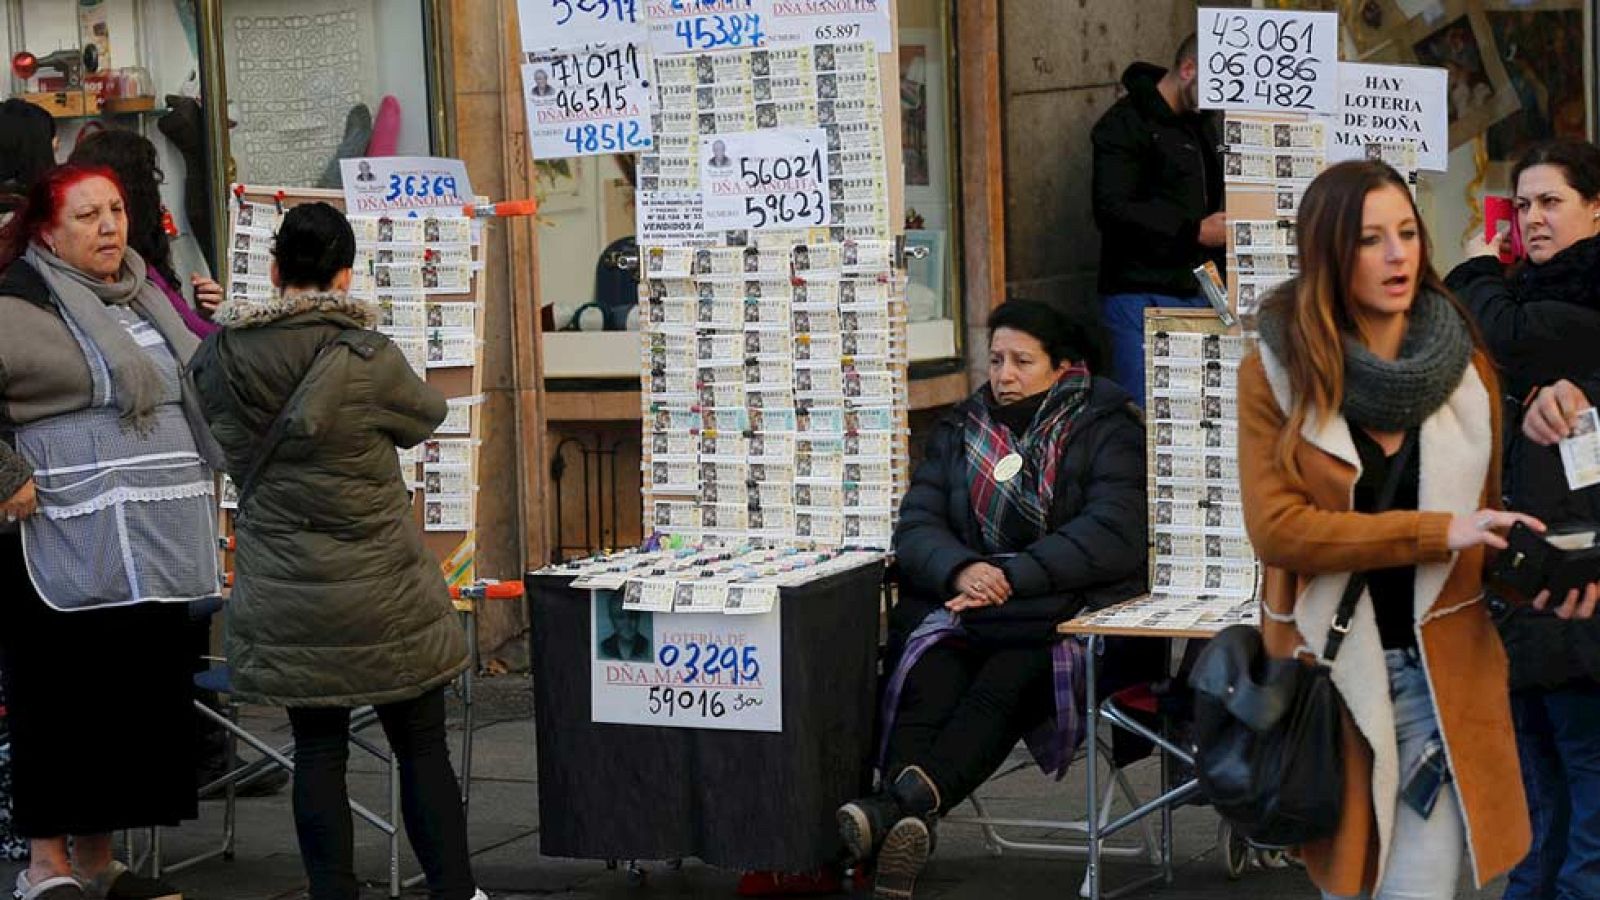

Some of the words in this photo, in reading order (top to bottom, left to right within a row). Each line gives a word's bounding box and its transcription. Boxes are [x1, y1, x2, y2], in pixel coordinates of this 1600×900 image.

[815, 24, 861, 40] 65.897
[1212, 13, 1314, 53] 43.061
[552, 42, 640, 87] 71071
[1209, 52, 1320, 82] 06.086
[1207, 79, 1315, 109] 32.482
[1365, 76, 1404, 91] HAY
[556, 82, 628, 116] 96515
[1344, 93, 1422, 113] LOTERIA
[1344, 113, 1368, 127] DE
[1372, 114, 1421, 132] DOÑA
[740, 149, 822, 188] 56021
[385, 174, 457, 201] 36369
[643, 222, 691, 231] VENDIDOS
[729, 633, 747, 645] DE
[659, 643, 759, 684] 03295
[649, 686, 726, 717] 59016
